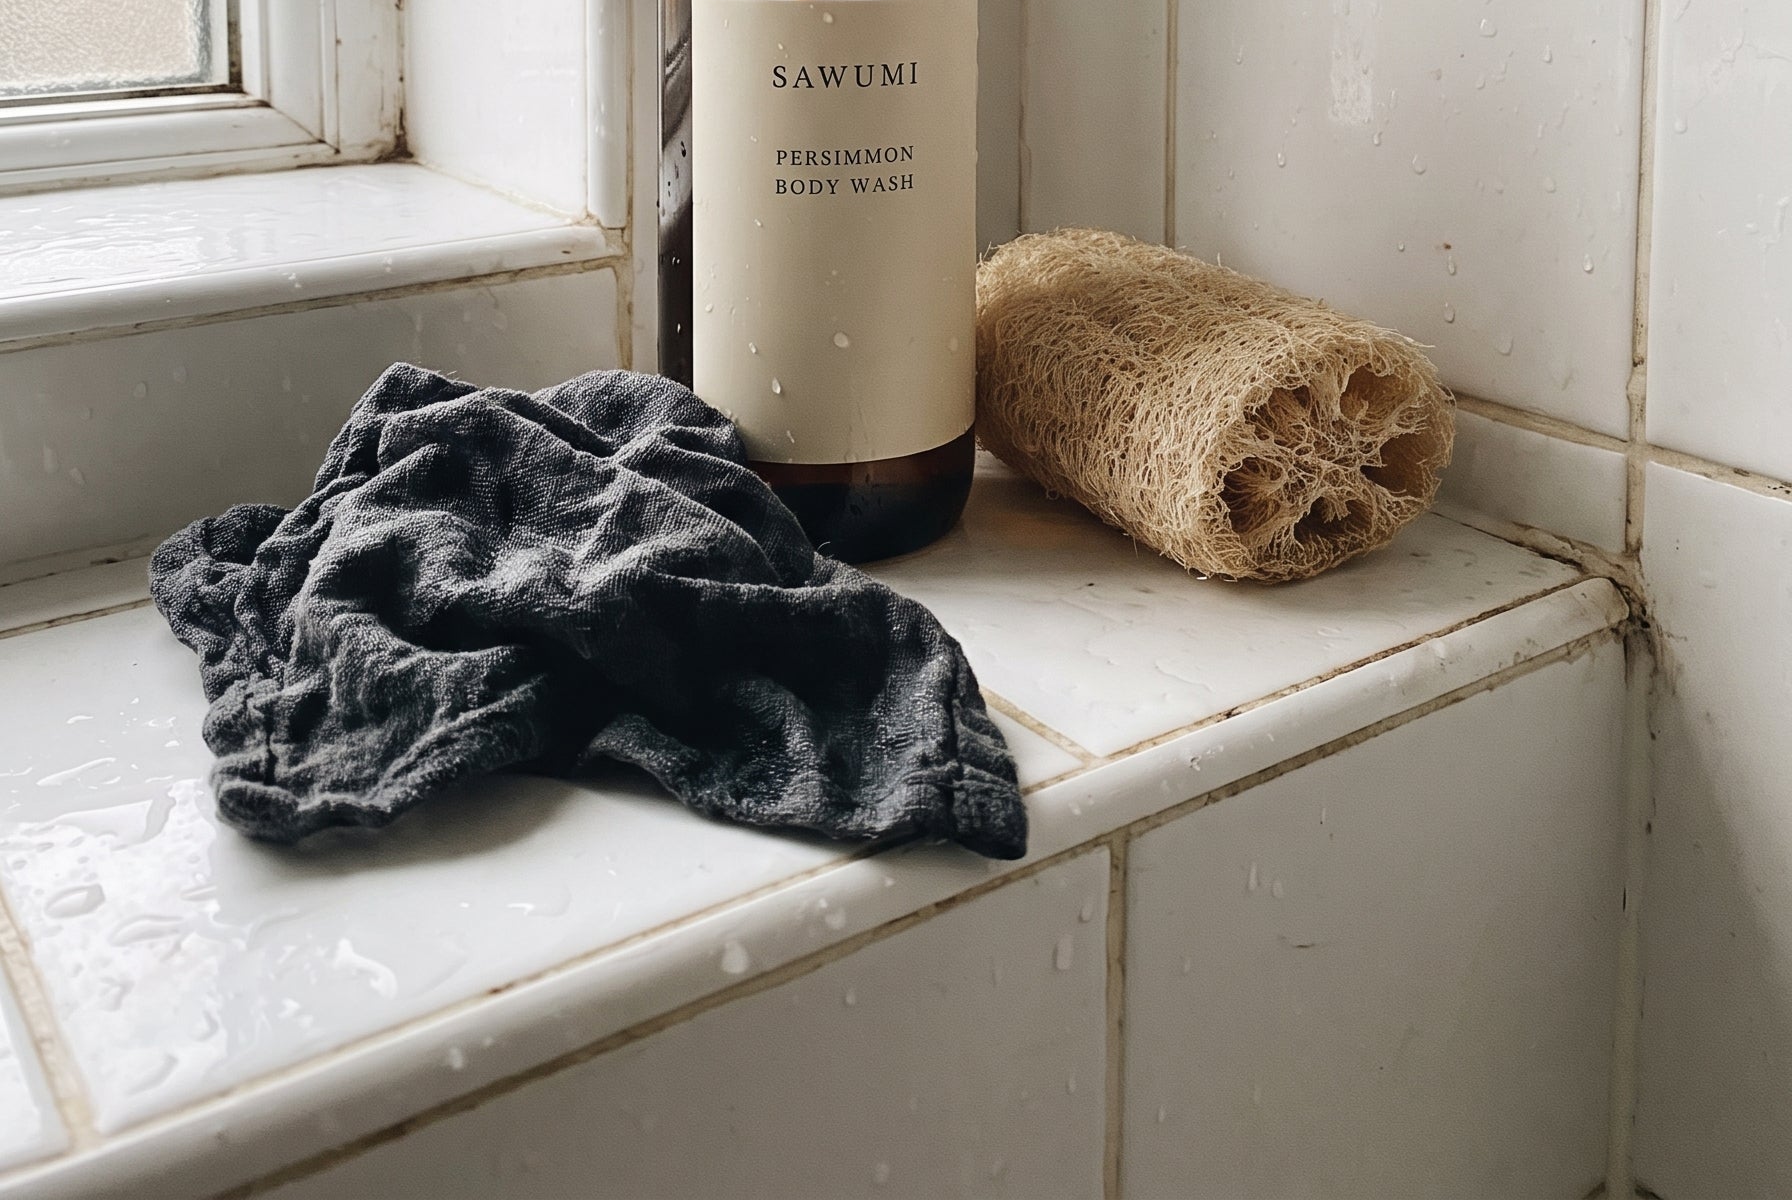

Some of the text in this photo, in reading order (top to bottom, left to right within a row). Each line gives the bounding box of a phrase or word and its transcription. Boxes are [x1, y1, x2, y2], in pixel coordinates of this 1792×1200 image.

[772, 61, 918, 89] SAWUMI
[776, 145, 914, 166] PERSIMMON
[775, 173, 914, 195] BODY WASH
